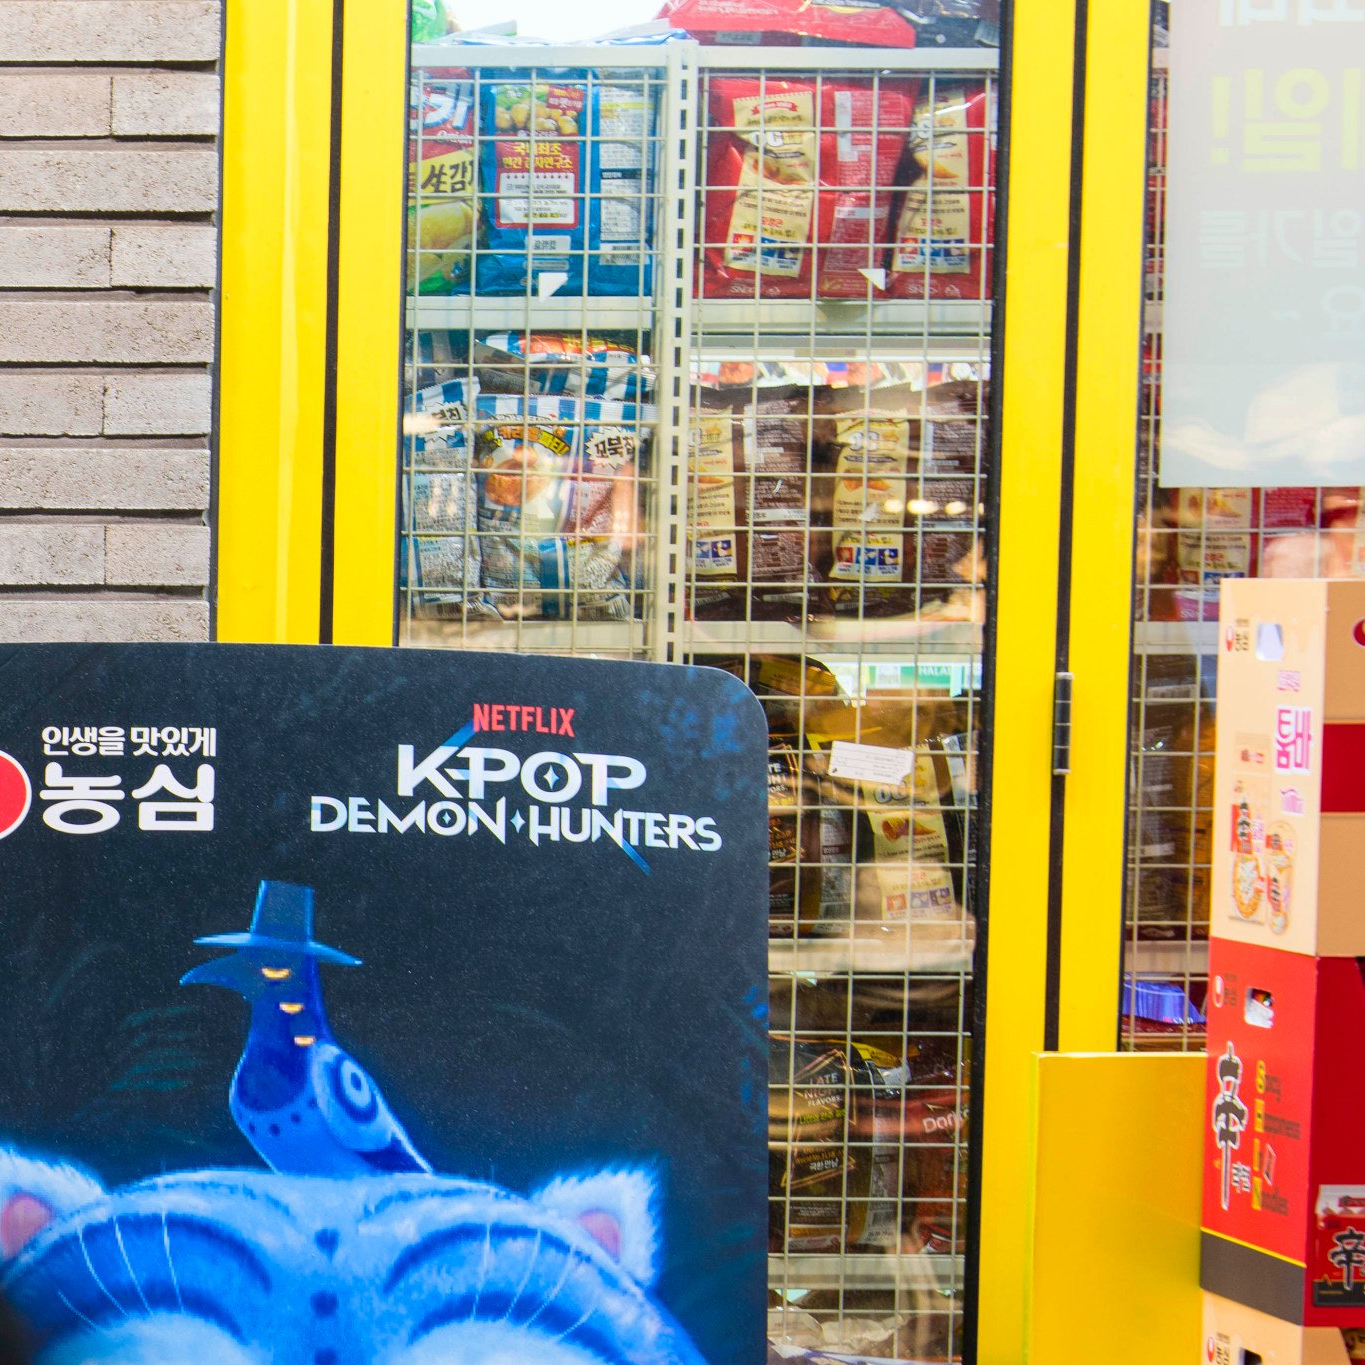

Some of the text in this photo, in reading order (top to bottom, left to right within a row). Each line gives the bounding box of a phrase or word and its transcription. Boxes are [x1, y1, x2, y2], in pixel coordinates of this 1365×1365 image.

[41, 726, 217, 758] 인생을 맛있게
[473, 702, 576, 738] NETFLIX
[38, 761, 216, 836] 농심
[396, 742, 648, 806] KPOP
[310, 795, 722, 854] DEMON HUNTERS
[1212, 1040, 1249, 1212] 辛
